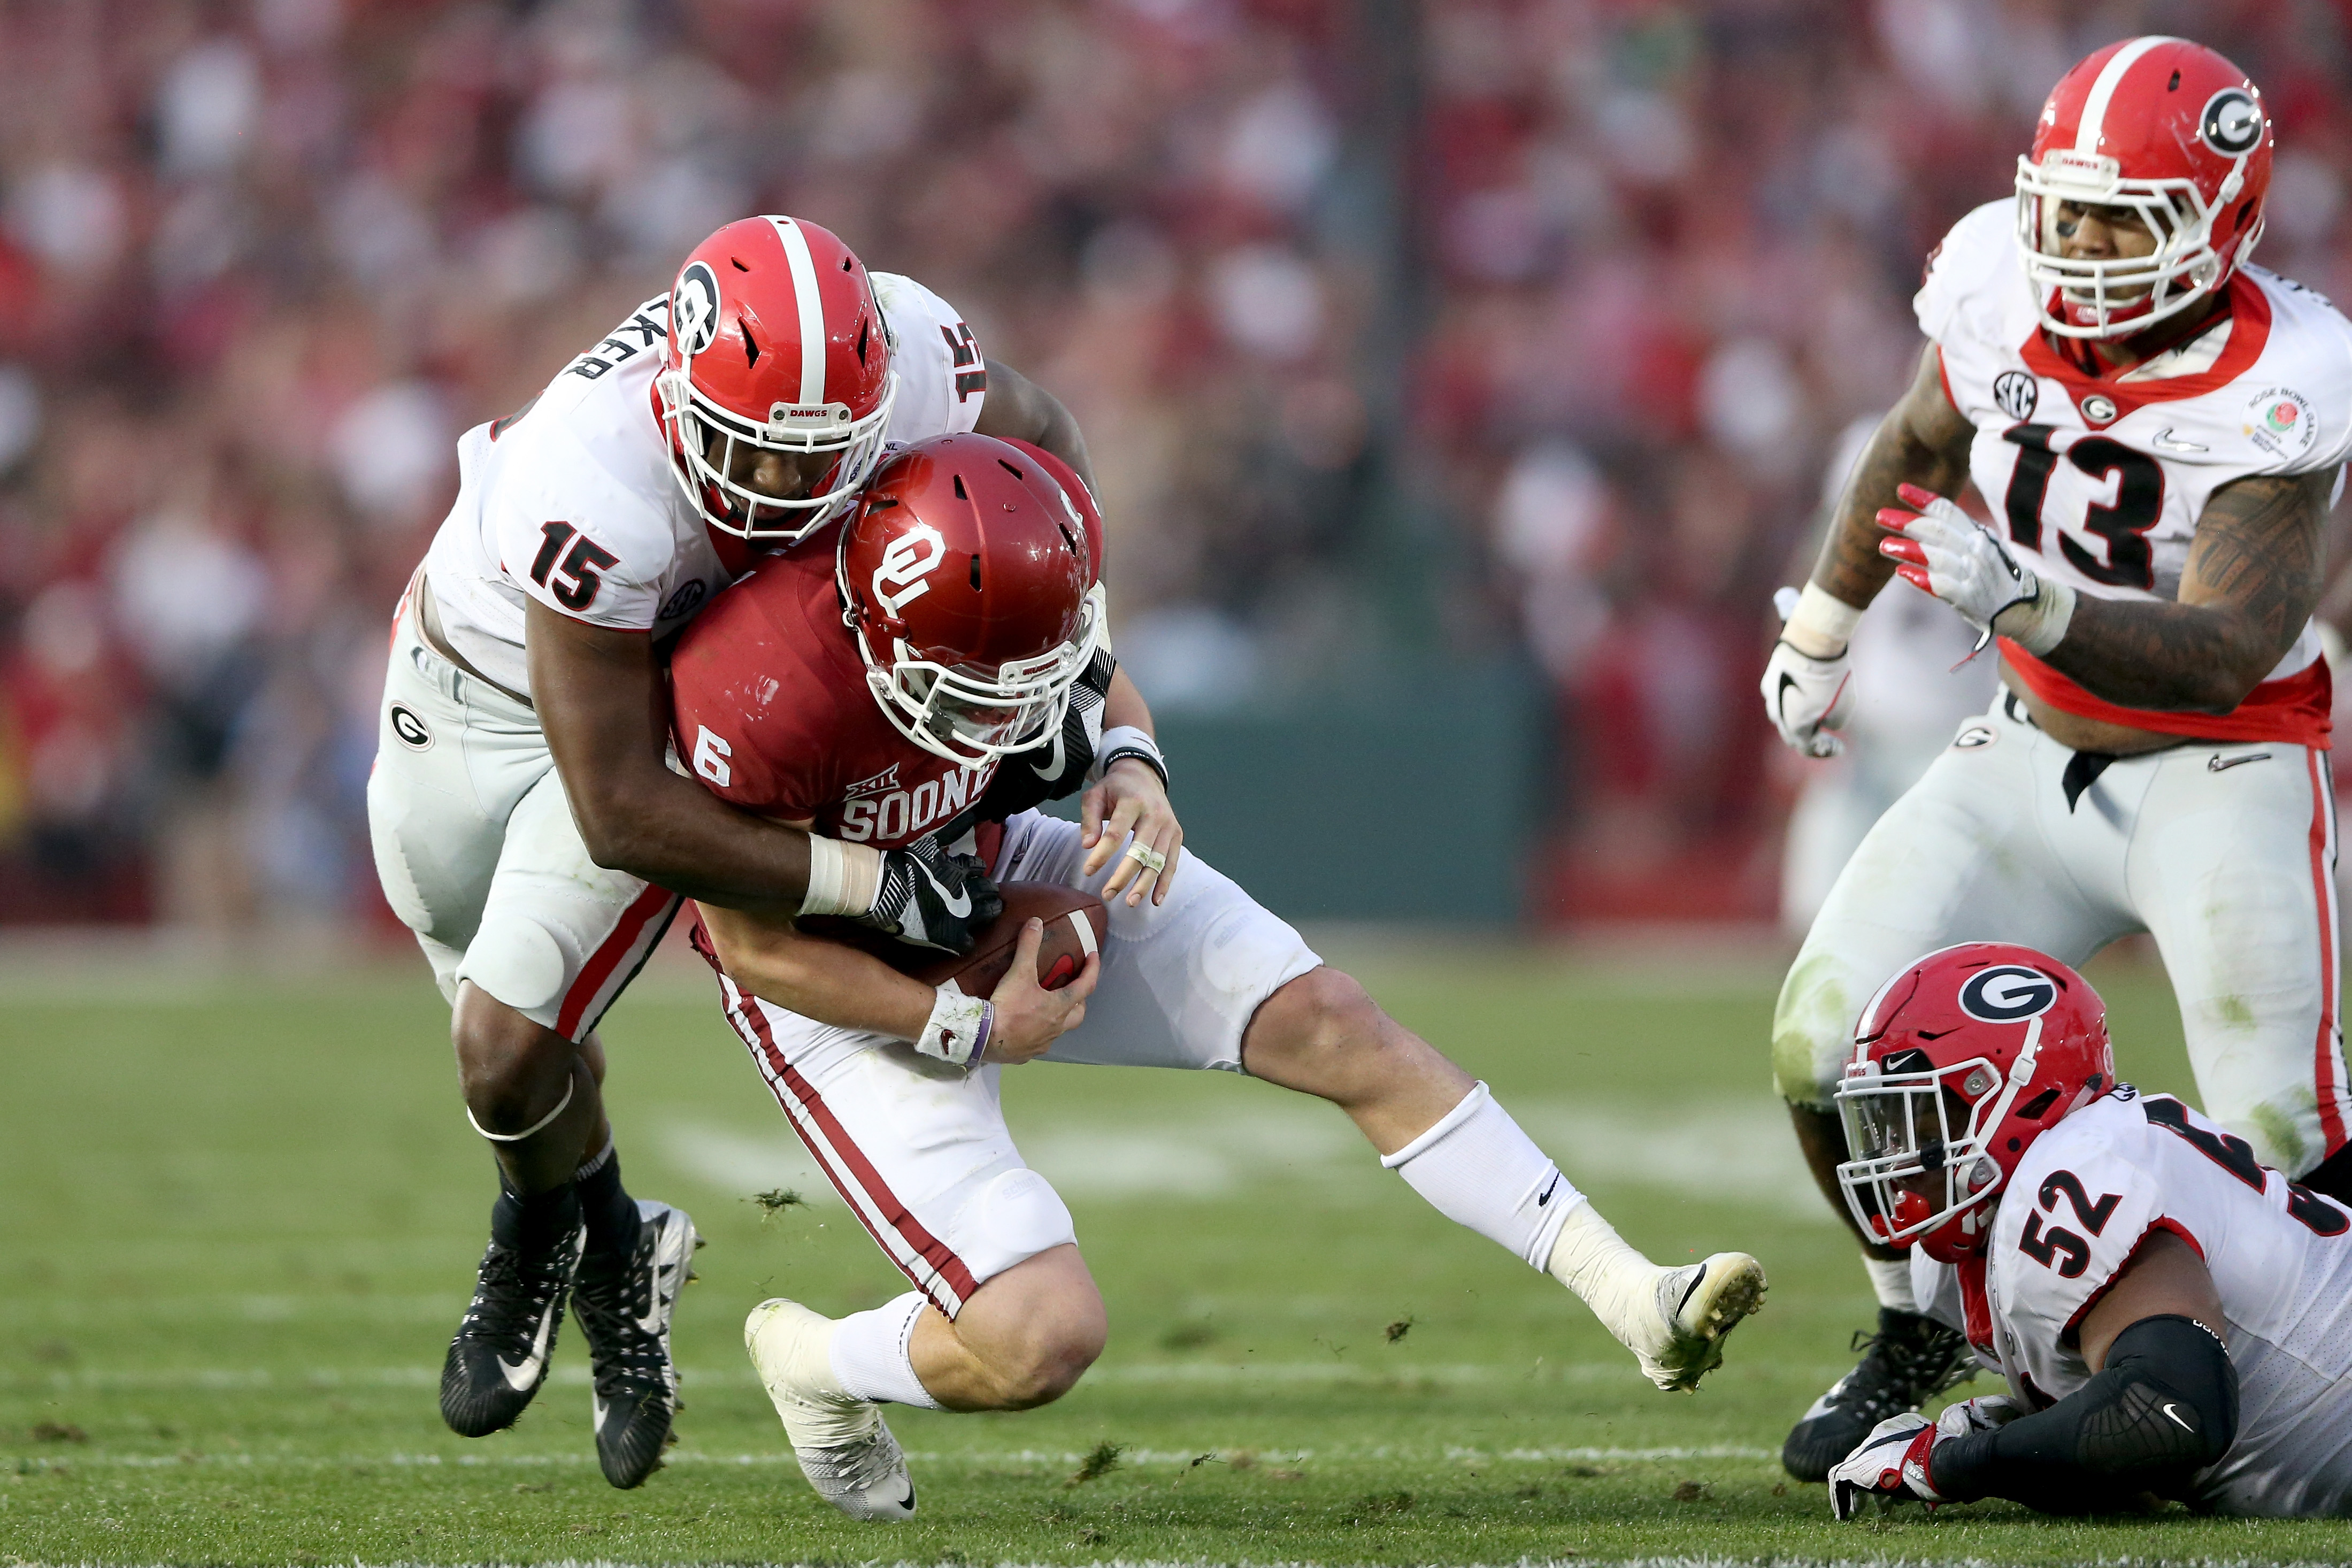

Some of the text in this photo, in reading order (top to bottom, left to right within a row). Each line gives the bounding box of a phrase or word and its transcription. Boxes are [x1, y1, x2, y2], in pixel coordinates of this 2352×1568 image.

[2202, 89, 2263, 155] G
[2002, 424, 2165, 589] 13
[530, 520, 620, 612] 15
[391, 703, 432, 749] G
[693, 725, 732, 787] 6
[840, 756, 1001, 842] SOONE
[1962, 967, 2055, 1020] G
[2018, 1170, 2123, 1279] 52
[1907, 1466, 1924, 1479] 4XL
